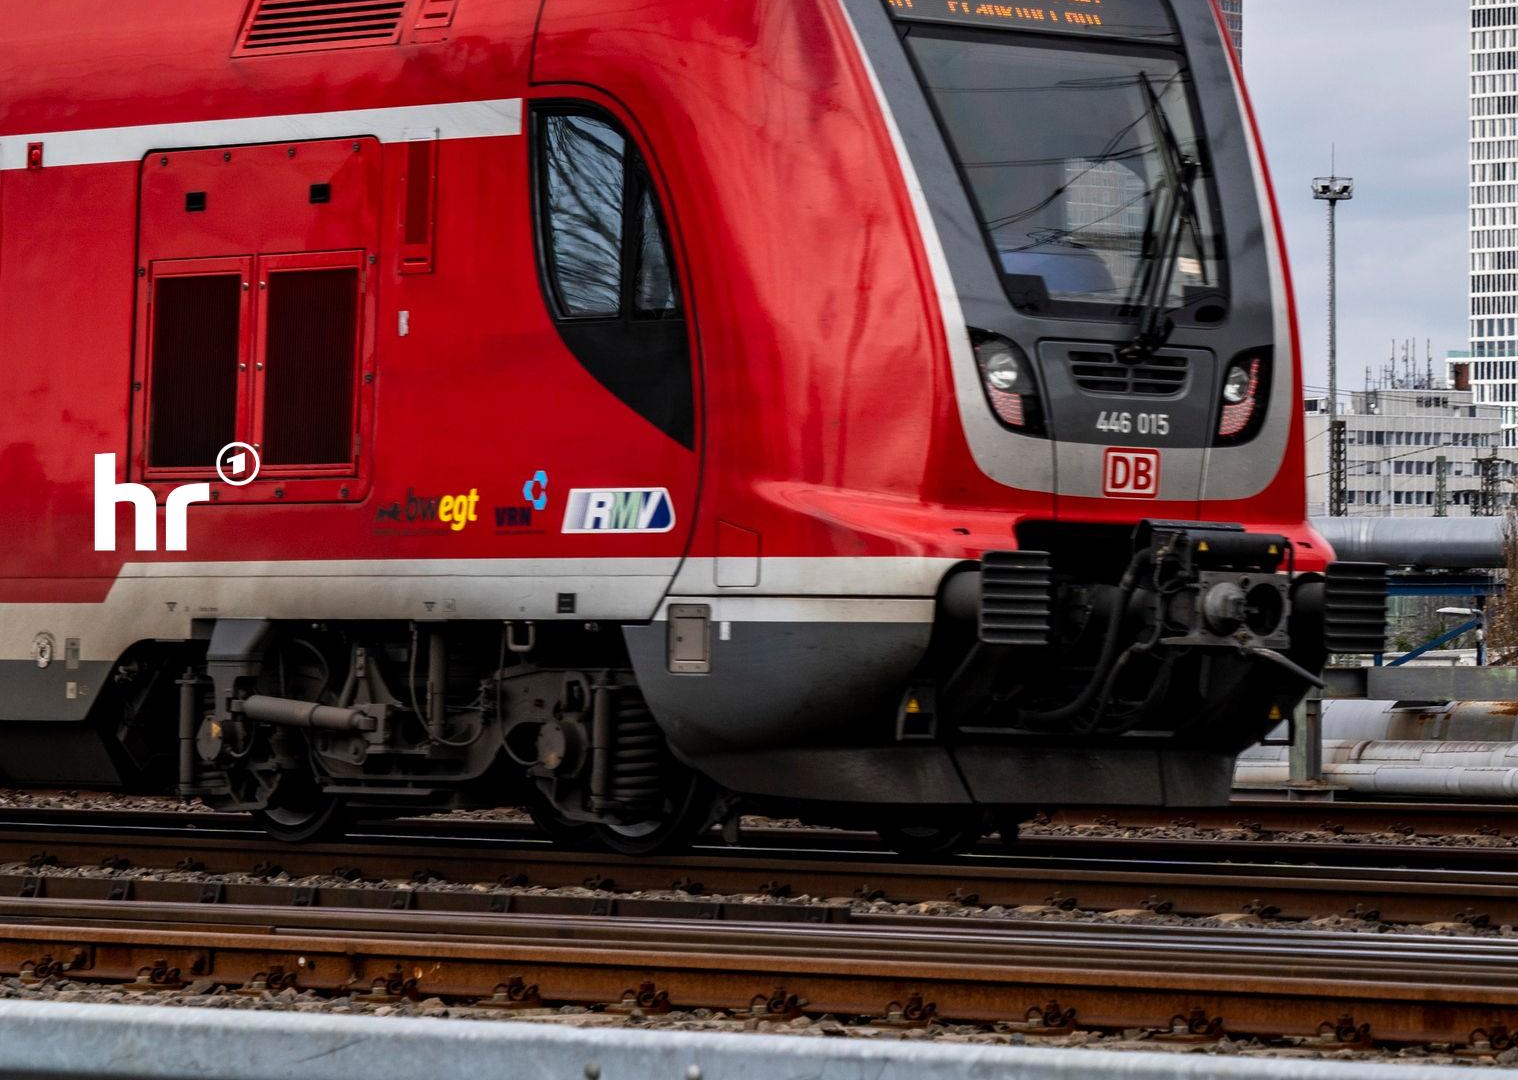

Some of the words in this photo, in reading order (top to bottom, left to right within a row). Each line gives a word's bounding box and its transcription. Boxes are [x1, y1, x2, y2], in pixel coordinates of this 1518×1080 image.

[1095, 411, 1132, 434] 446
[1136, 413, 1171, 436] 015
[1110, 455, 1153, 491] DB
[405, 487, 480, 532] bwegt
[582, 491, 665, 529] RMV
